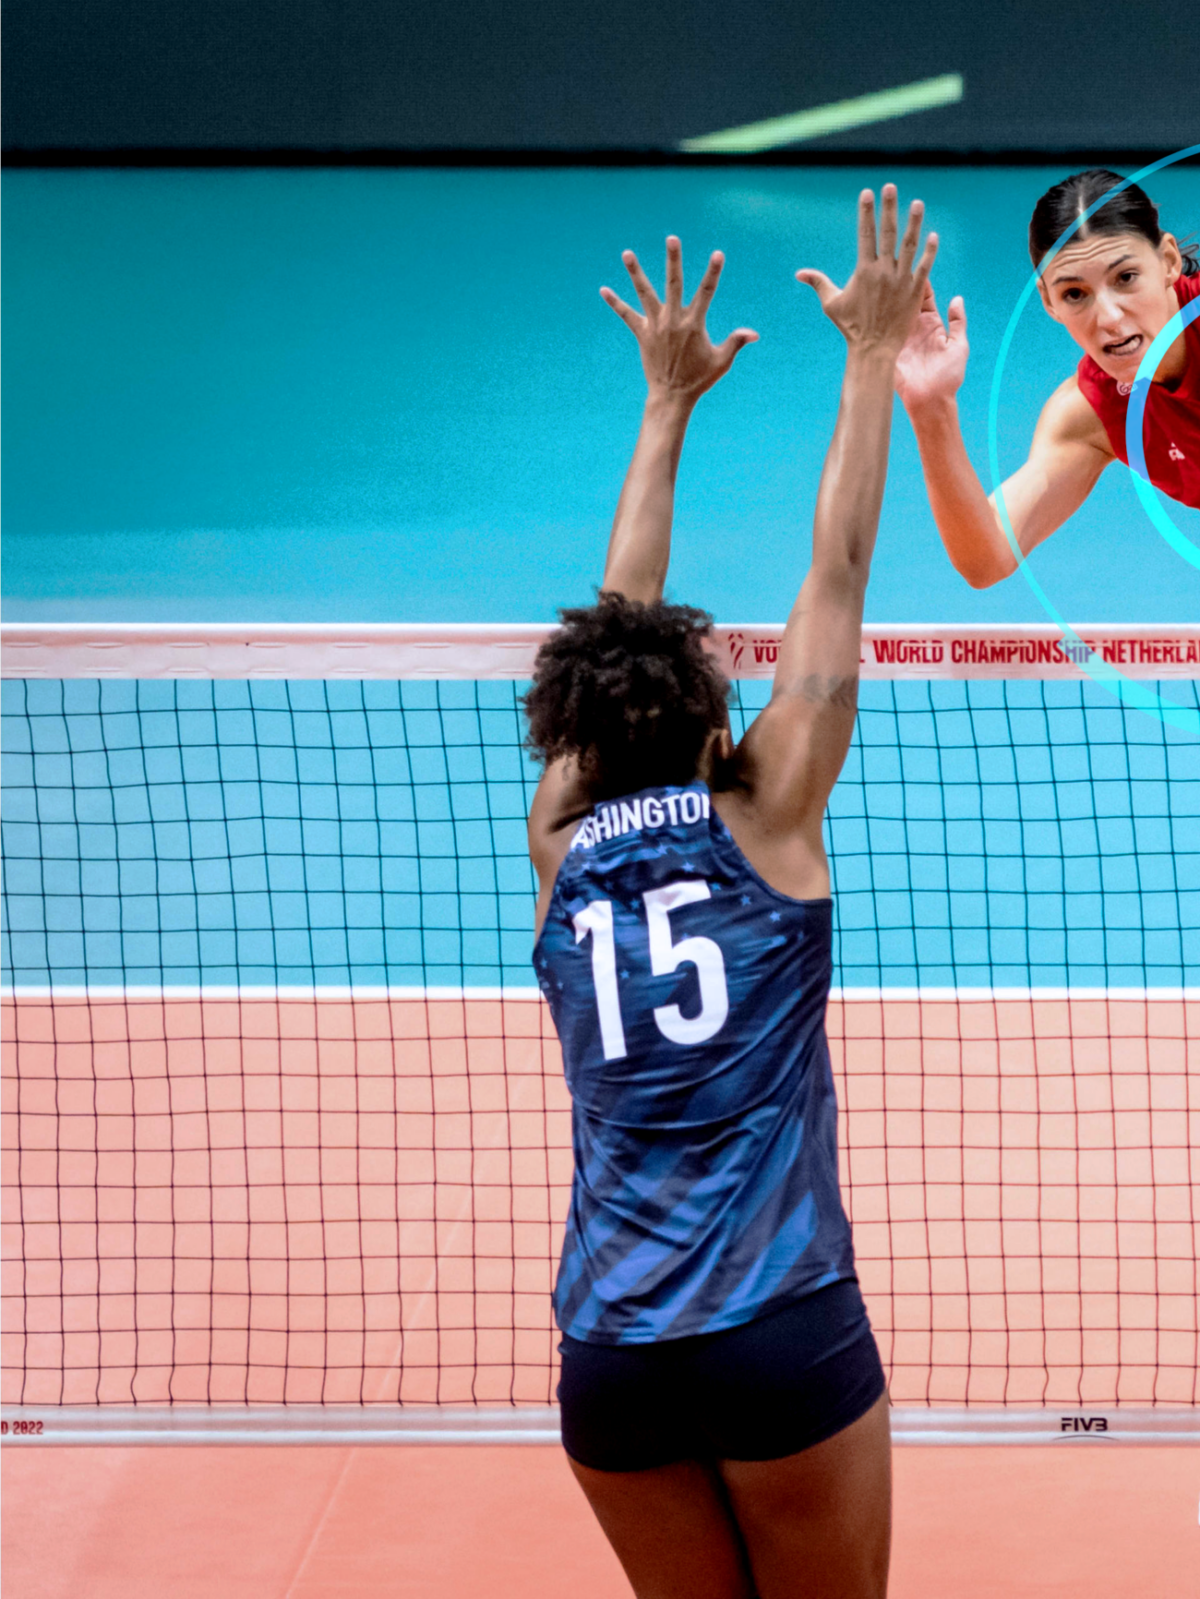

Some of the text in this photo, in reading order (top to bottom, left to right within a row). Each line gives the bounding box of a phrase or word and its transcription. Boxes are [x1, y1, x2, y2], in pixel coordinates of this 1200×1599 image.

[873, 639, 944, 664] WORLD
[951, 639, 1096, 664] CHAMPIONSHIP
[570, 791, 710, 849] ASHINGTO
[572, 879, 729, 1060] 15
[13, 1420, 44, 1435] 2022
[1061, 1417, 1108, 1432] FIVB
